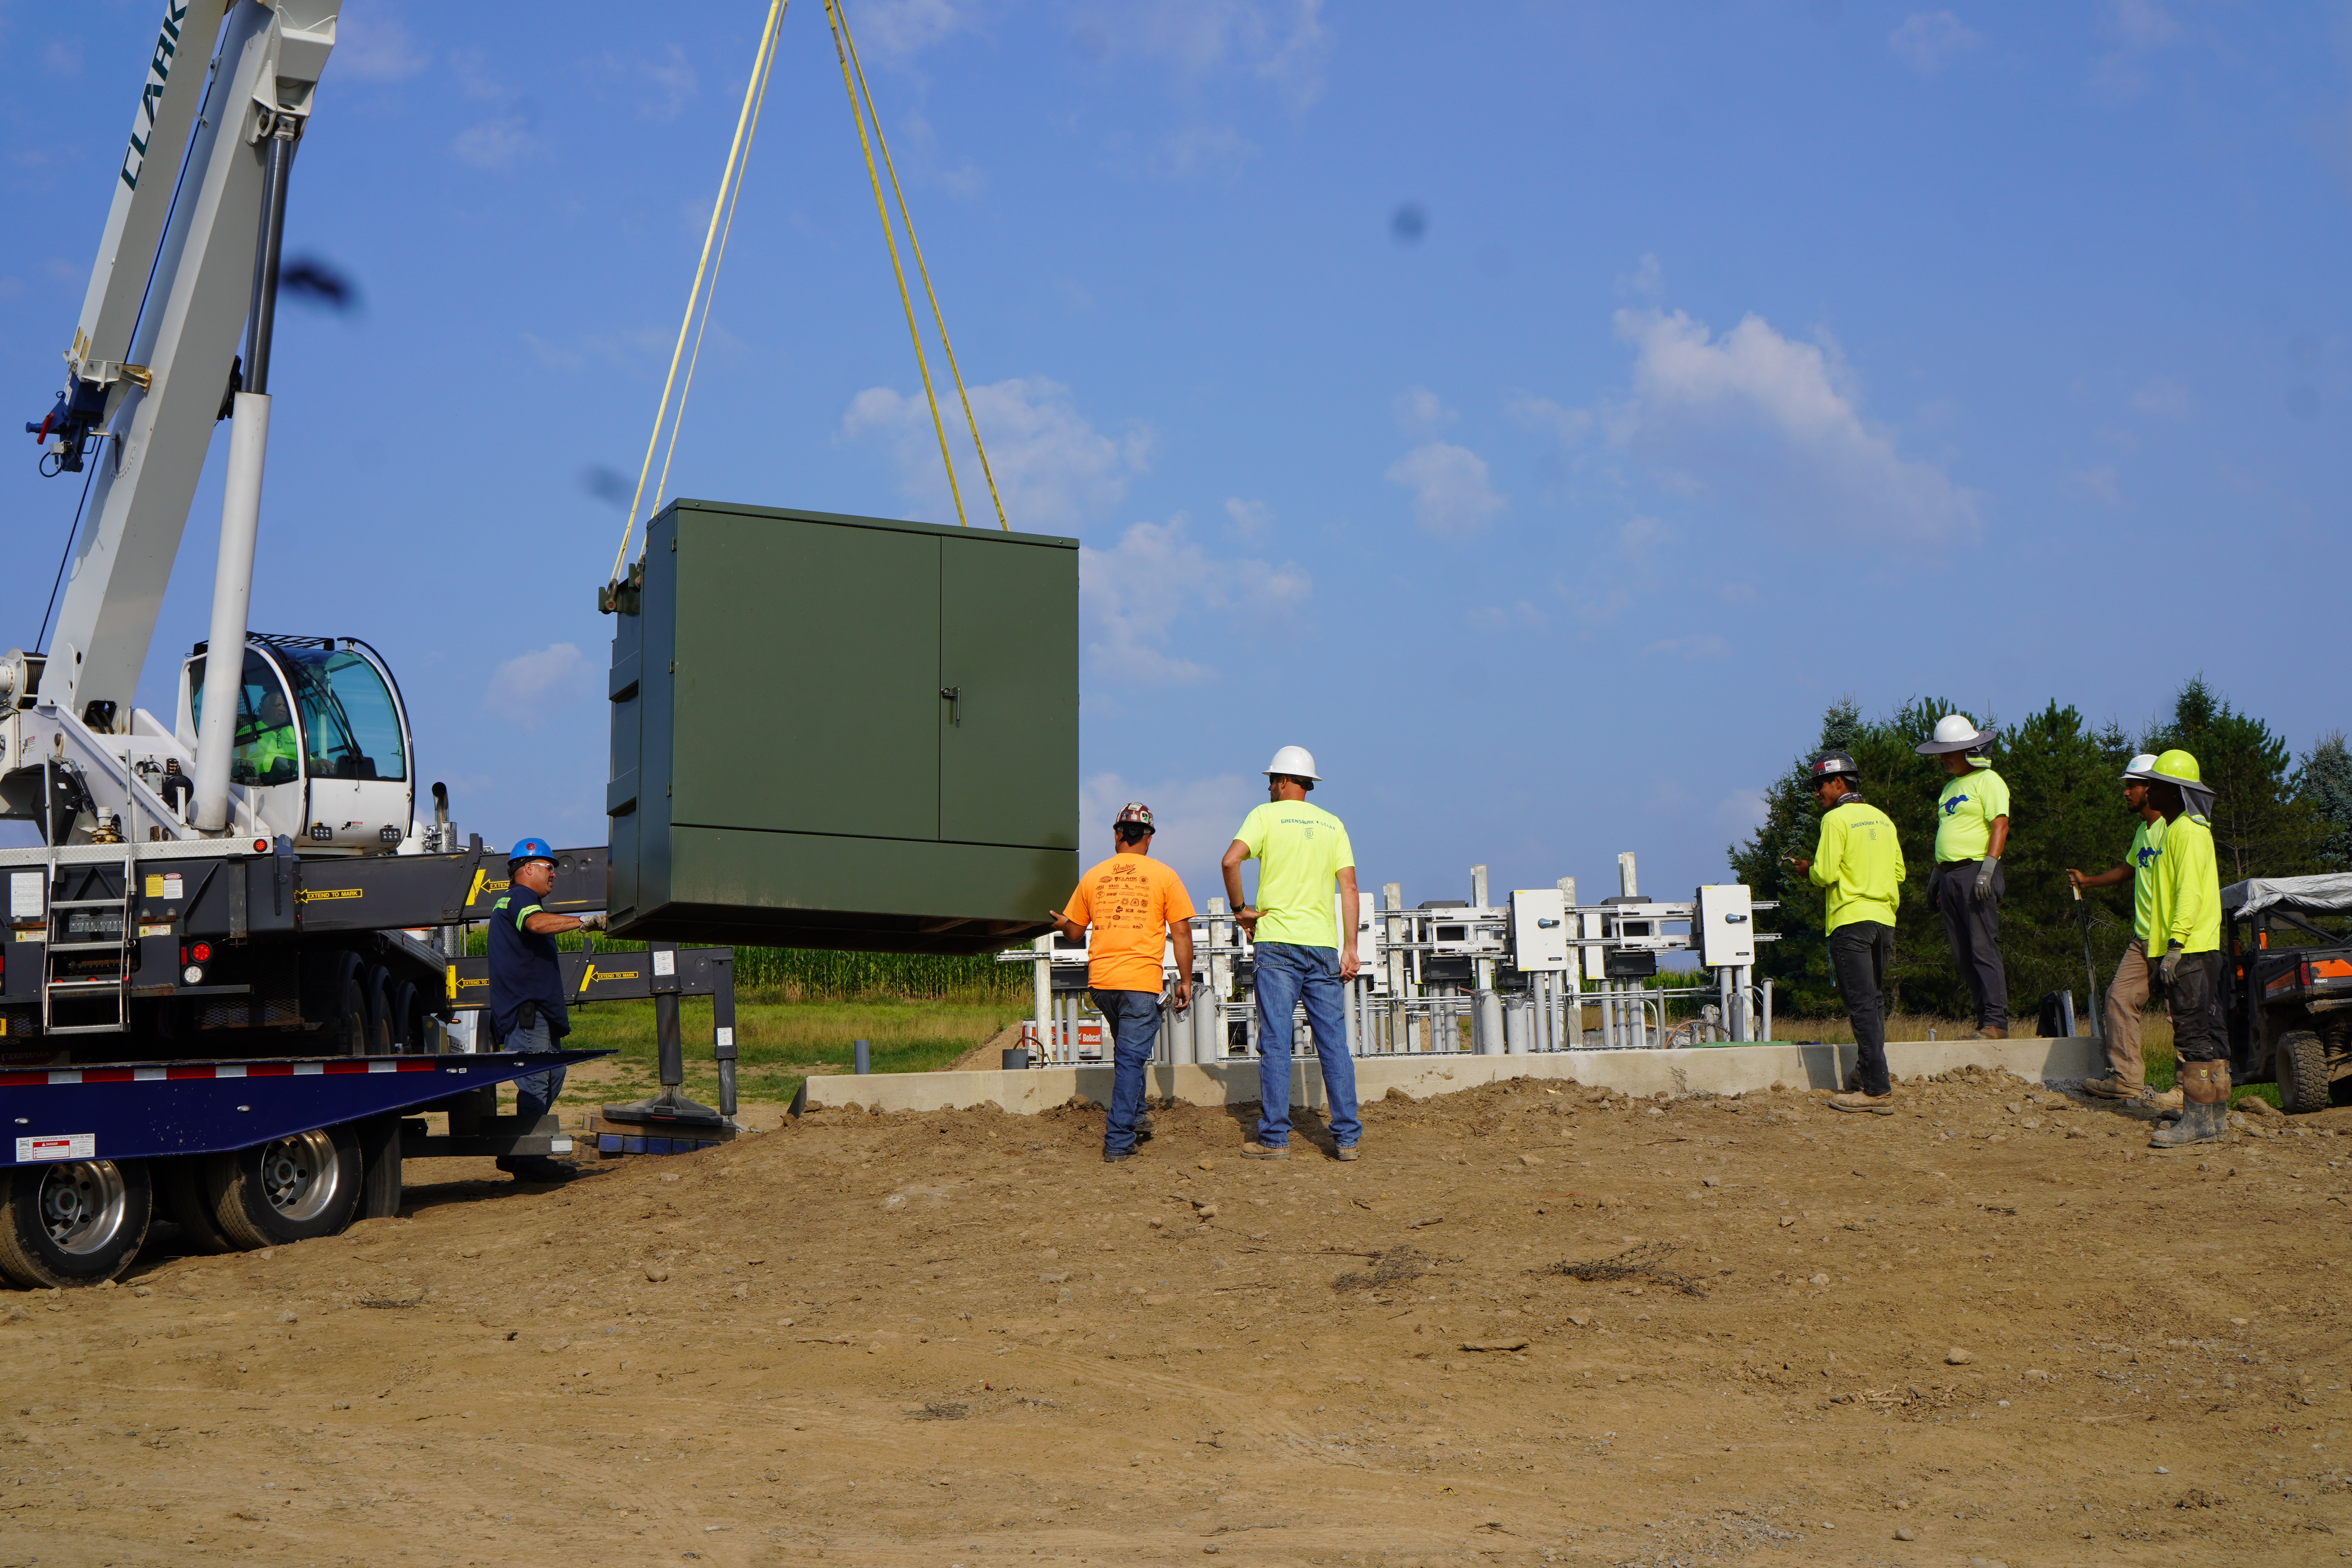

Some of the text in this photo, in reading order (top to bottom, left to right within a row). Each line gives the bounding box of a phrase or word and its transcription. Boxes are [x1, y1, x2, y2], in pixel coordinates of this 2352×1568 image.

[121, 0, 187, 191] CLARK
[1320, 822, 1336, 830] SOLAR
[1111, 864, 1136, 874] Boulter
[1083, 1034, 1100, 1042] Bobcat
